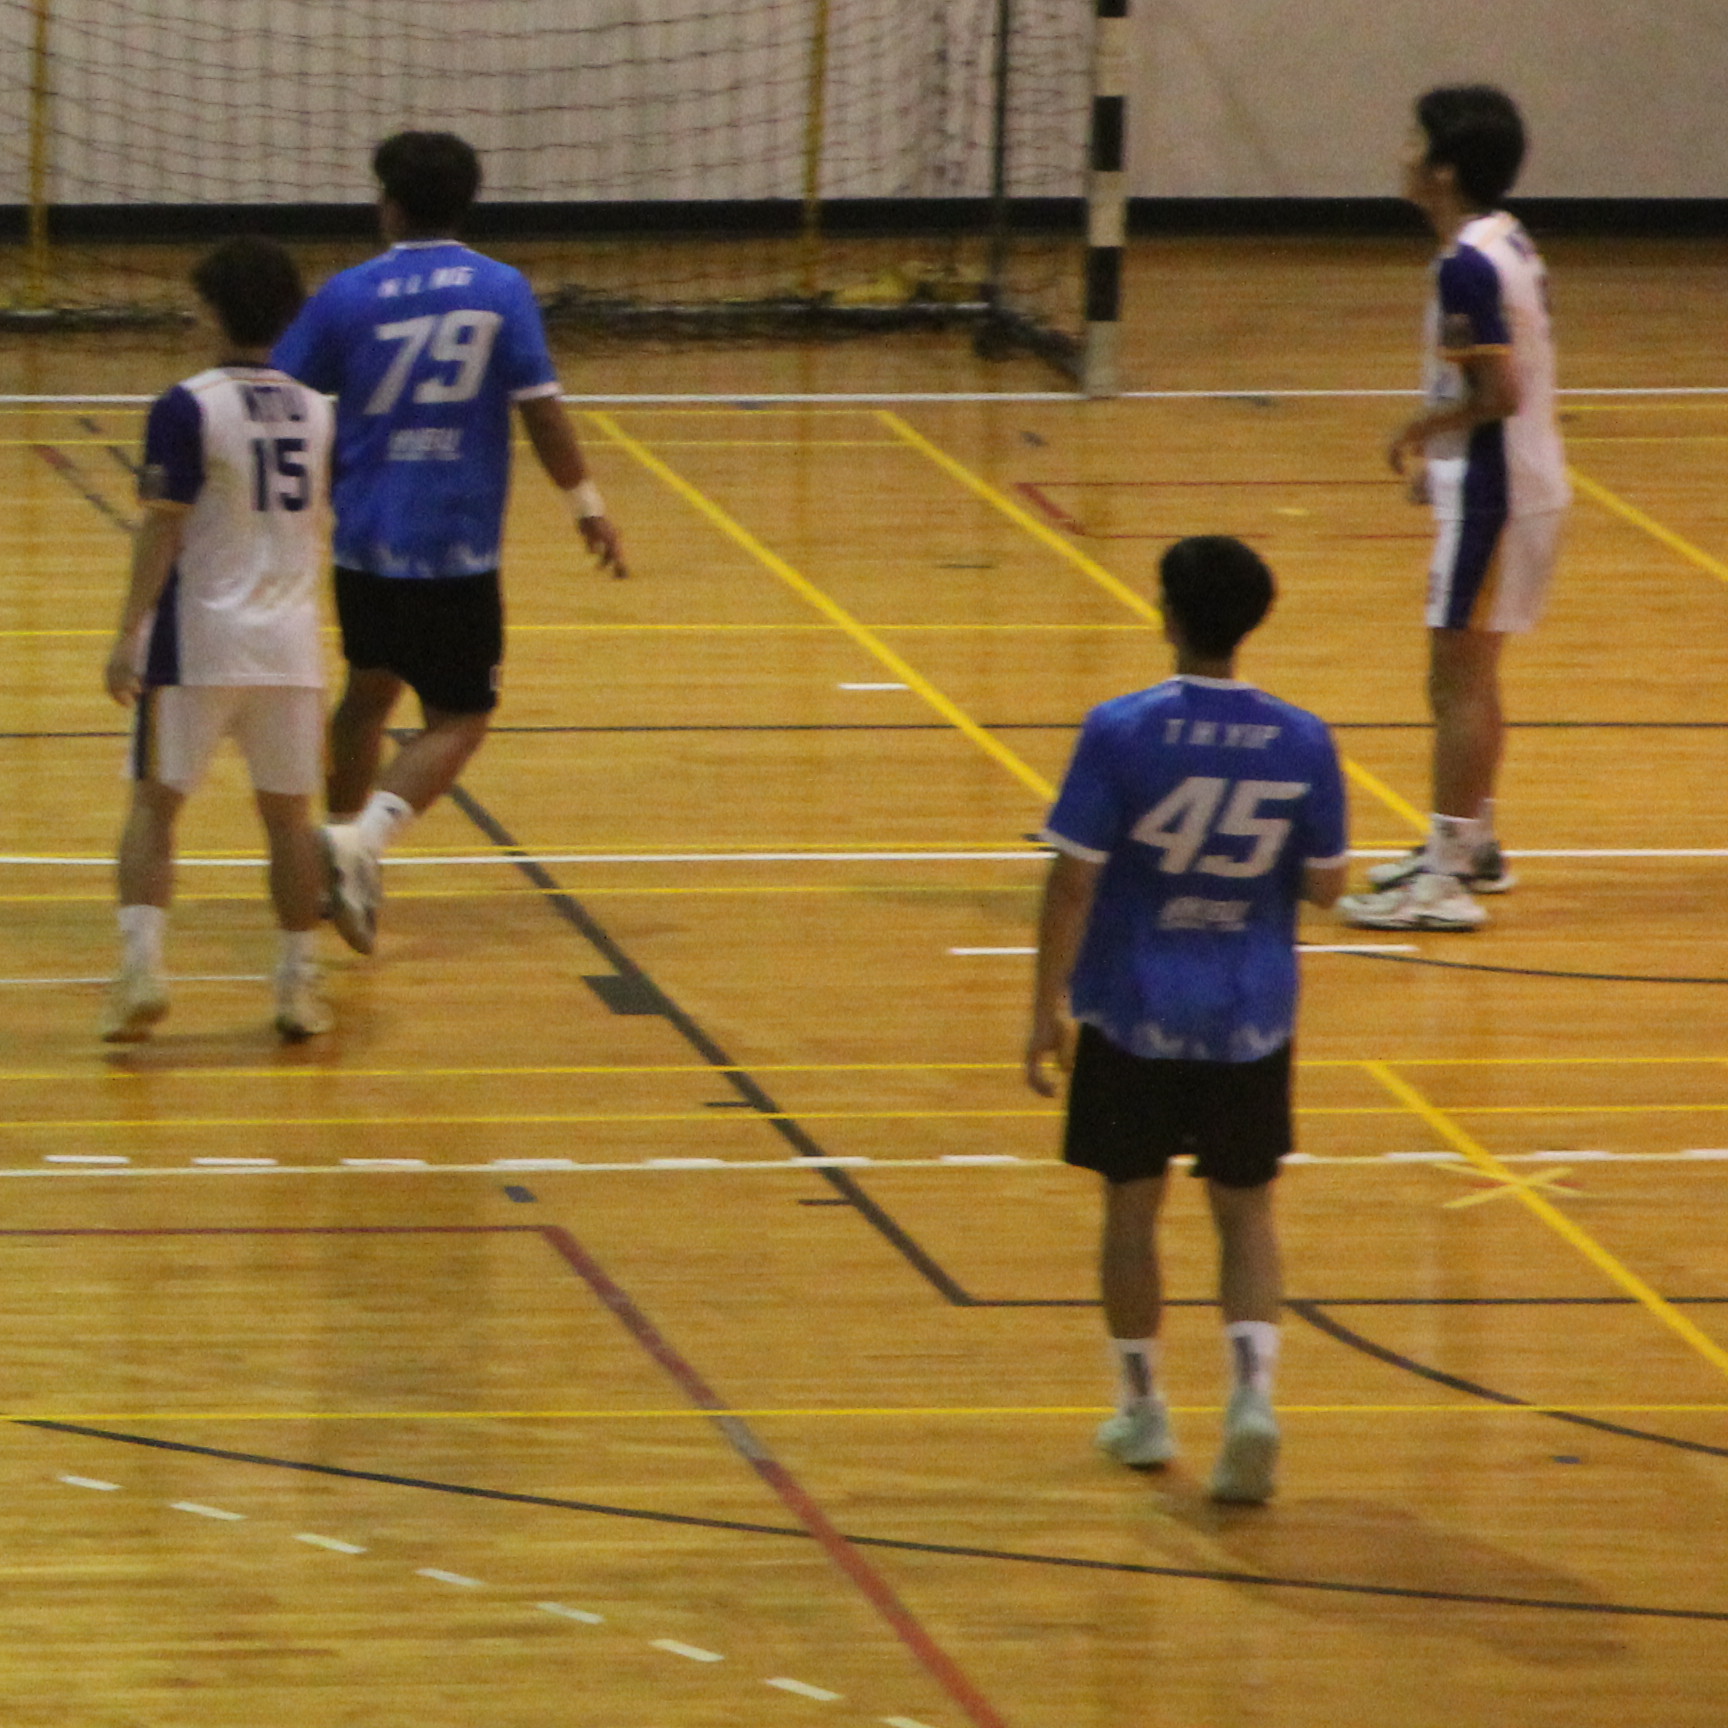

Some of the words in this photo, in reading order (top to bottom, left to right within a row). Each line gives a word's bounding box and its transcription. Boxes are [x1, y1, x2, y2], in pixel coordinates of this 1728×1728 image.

[363, 309, 504, 415] 79
[250, 438, 310, 511] 15
[1131, 776, 1312, 878] 45
